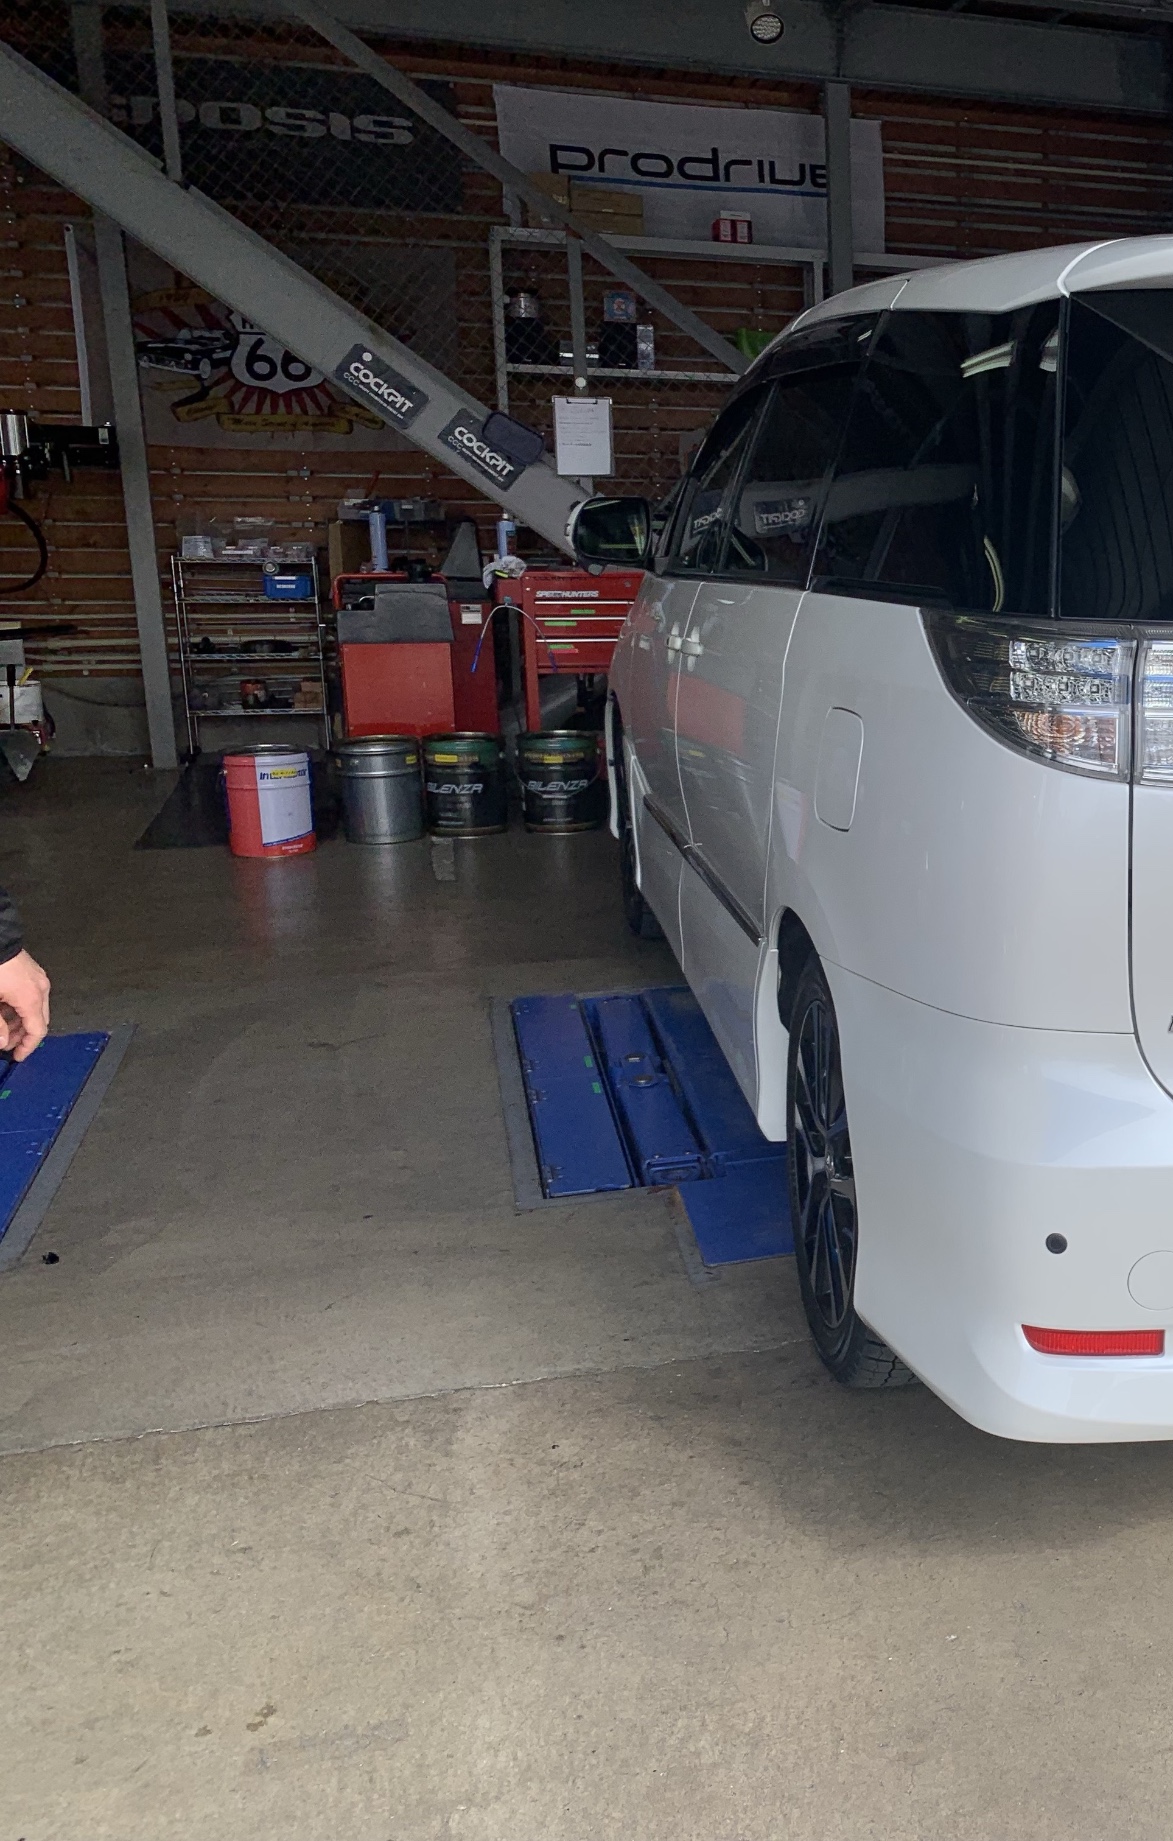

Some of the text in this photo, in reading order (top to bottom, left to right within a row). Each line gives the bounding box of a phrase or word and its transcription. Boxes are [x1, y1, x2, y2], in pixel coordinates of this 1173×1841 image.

[245, 337, 313, 382] 66
[343, 371, 360, 386] CCC
[349, 362, 414, 413] COCKPIT
[447, 435, 463, 450] CCC
[454, 426, 515, 476] COCKPIT
